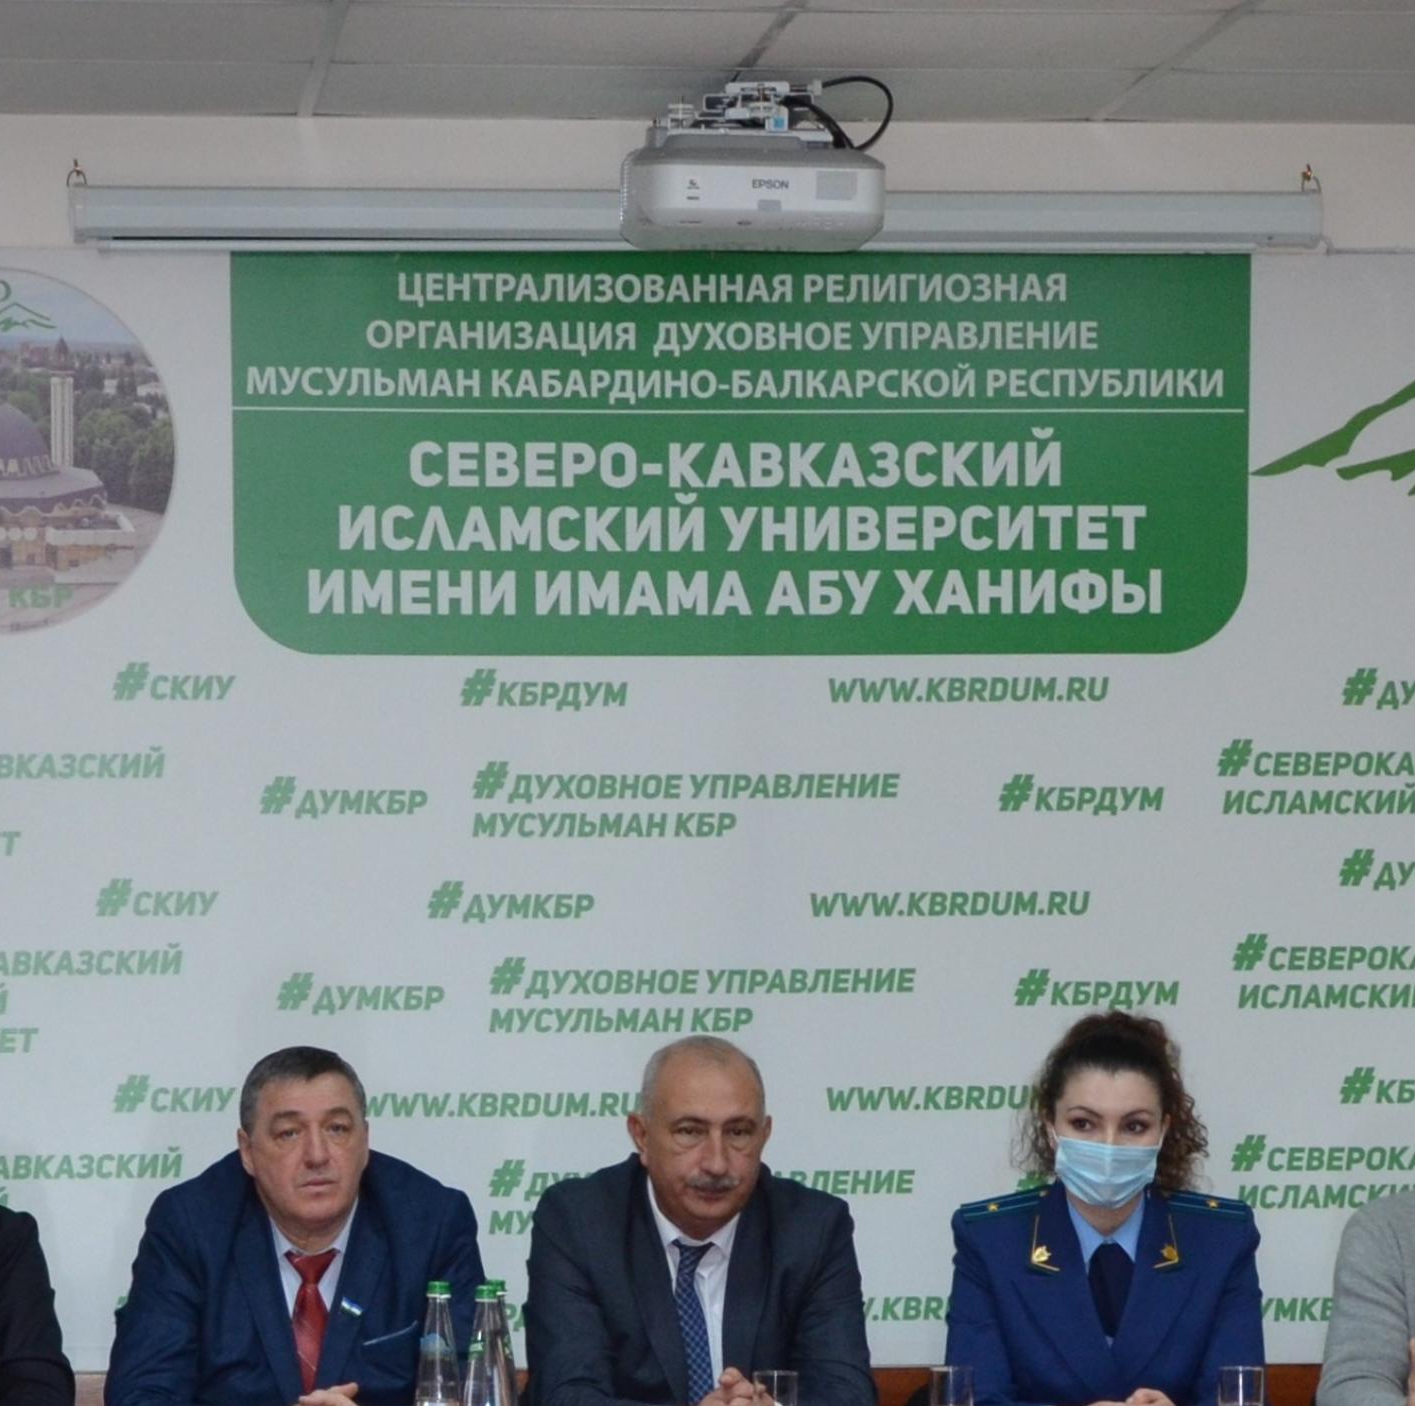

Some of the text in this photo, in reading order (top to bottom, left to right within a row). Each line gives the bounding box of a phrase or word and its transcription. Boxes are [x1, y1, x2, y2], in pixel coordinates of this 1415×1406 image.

[751, 179, 789, 189] EPSON
[400, 274, 1065, 306] ЦЕНТРАЛИЗОВАННАЯ РЕЛИГИОЗНАЯ
[367, 321, 1096, 356] ОРГАНИЗАЦИЯ ДУХОВНОЕ УПРАВЛЕНИЕ
[247, 364, 1222, 404] МУСУЛЬМАН КАБАРДИНО-БАЛКАРСКОЙ РЕСПУБЛИКИ
[410, 428, 1060, 487] СЕВЕРО-КАВКАЗСКИЙ
[340, 493, 1145, 551] ИСЛАМСКИЙ УНИВЕРСИТЕТ
[9, 586, 73, 608] КБР
[309, 569, 1161, 615] ИМЕНИ ИМАМА АБУ ХАНИФЫ
[113, 662, 236, 700] #СКИУ
[461, 669, 627, 711] #КБРДУМ
[829, 677, 1109, 703] WWW.KBRDUM.RU
[260, 776, 428, 819] #ДУМКБР
[472, 761, 900, 804] #ДУХОВНОЕ УПРАВЛЕНИЕ
[998, 774, 1164, 816] #КБРДУМ
[472, 812, 737, 838] МУСУЛЬМАН КБР
[96, 879, 218, 917] #СКИУ
[427, 881, 595, 924] #ДУМКБР
[810, 891, 1090, 917] WWW.KBRDUM.RU
[277, 972, 445, 1016] #ДУМКБР
[489, 957, 916, 999] #ДУХОВНОЕ УПРАВЛЕНИЕ
[1014, 968, 1180, 1012] #КБРДУМ
[489, 1007, 754, 1034] МУСУЛЬМАН КБР
[113, 1074, 236, 1113] #СКИУ
[827, 1086, 1032, 1111] WWW.KBRDU
